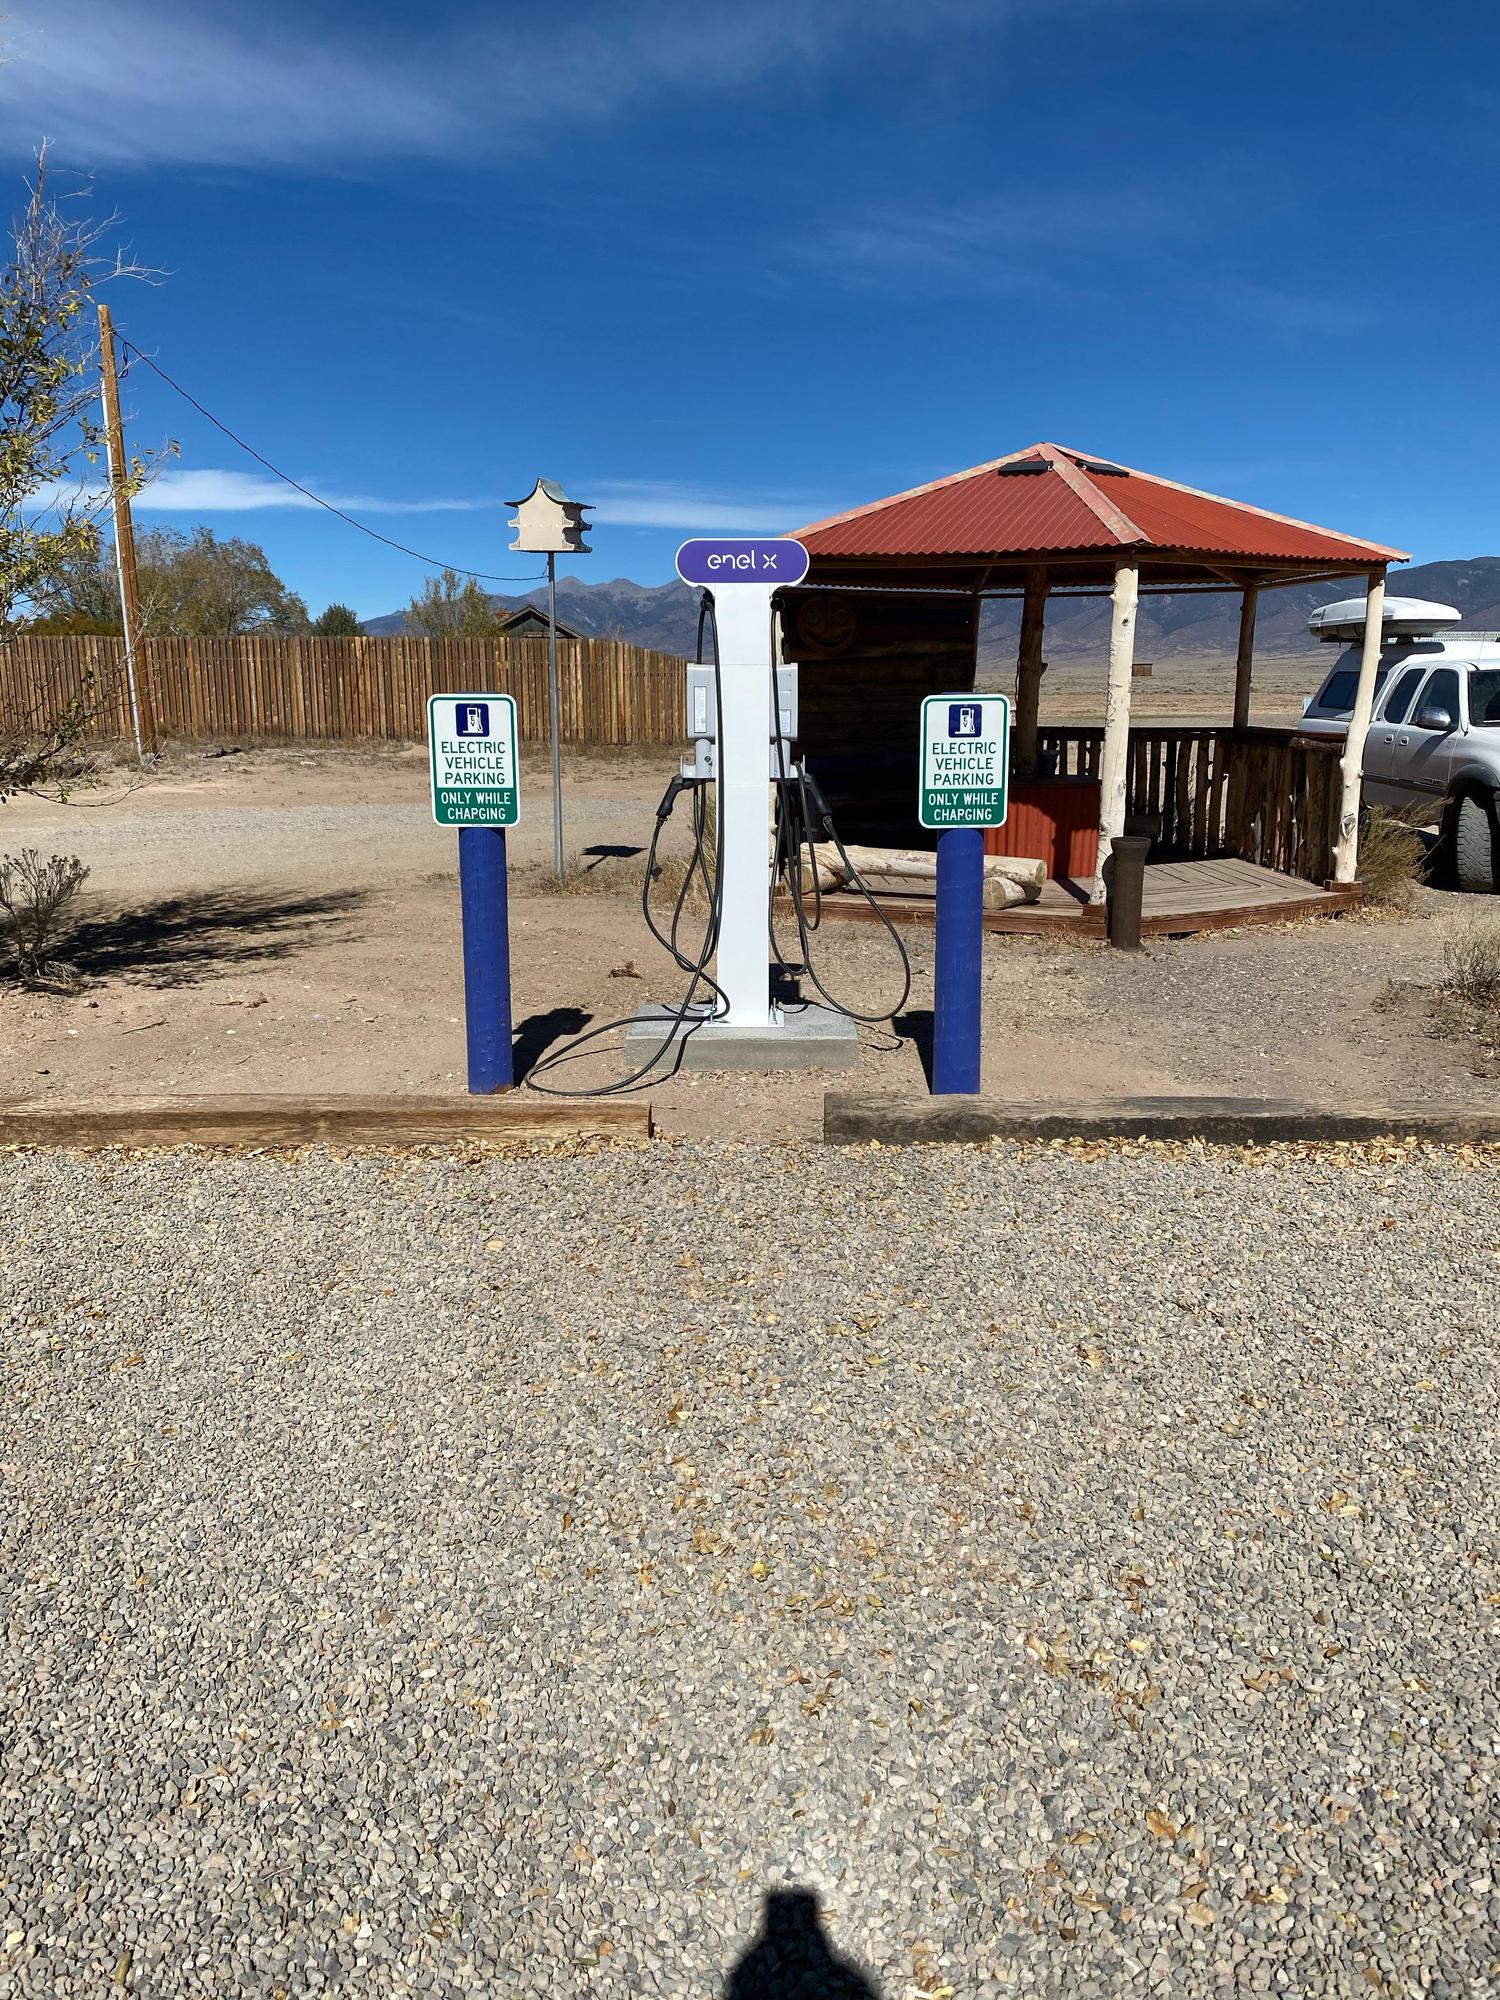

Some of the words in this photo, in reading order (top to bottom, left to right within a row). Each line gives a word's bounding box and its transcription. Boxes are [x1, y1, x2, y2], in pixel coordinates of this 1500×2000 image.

[707, 550, 756, 569] enel
[763, 554, 777, 569] x
[441, 741, 505, 753] ELECTRIC
[933, 742, 996, 754] ELECTRIC
[446, 757, 504, 769] VEHICLE
[936, 758, 993, 770] VEHICLE
[445, 773, 505, 784] PARKING
[934, 773, 994, 785] PARKING
[441, 792, 471, 804] ONLY
[476, 792, 511, 804] WHILE
[929, 793, 959, 805] ONLY
[963, 793, 998, 805] WHILE
